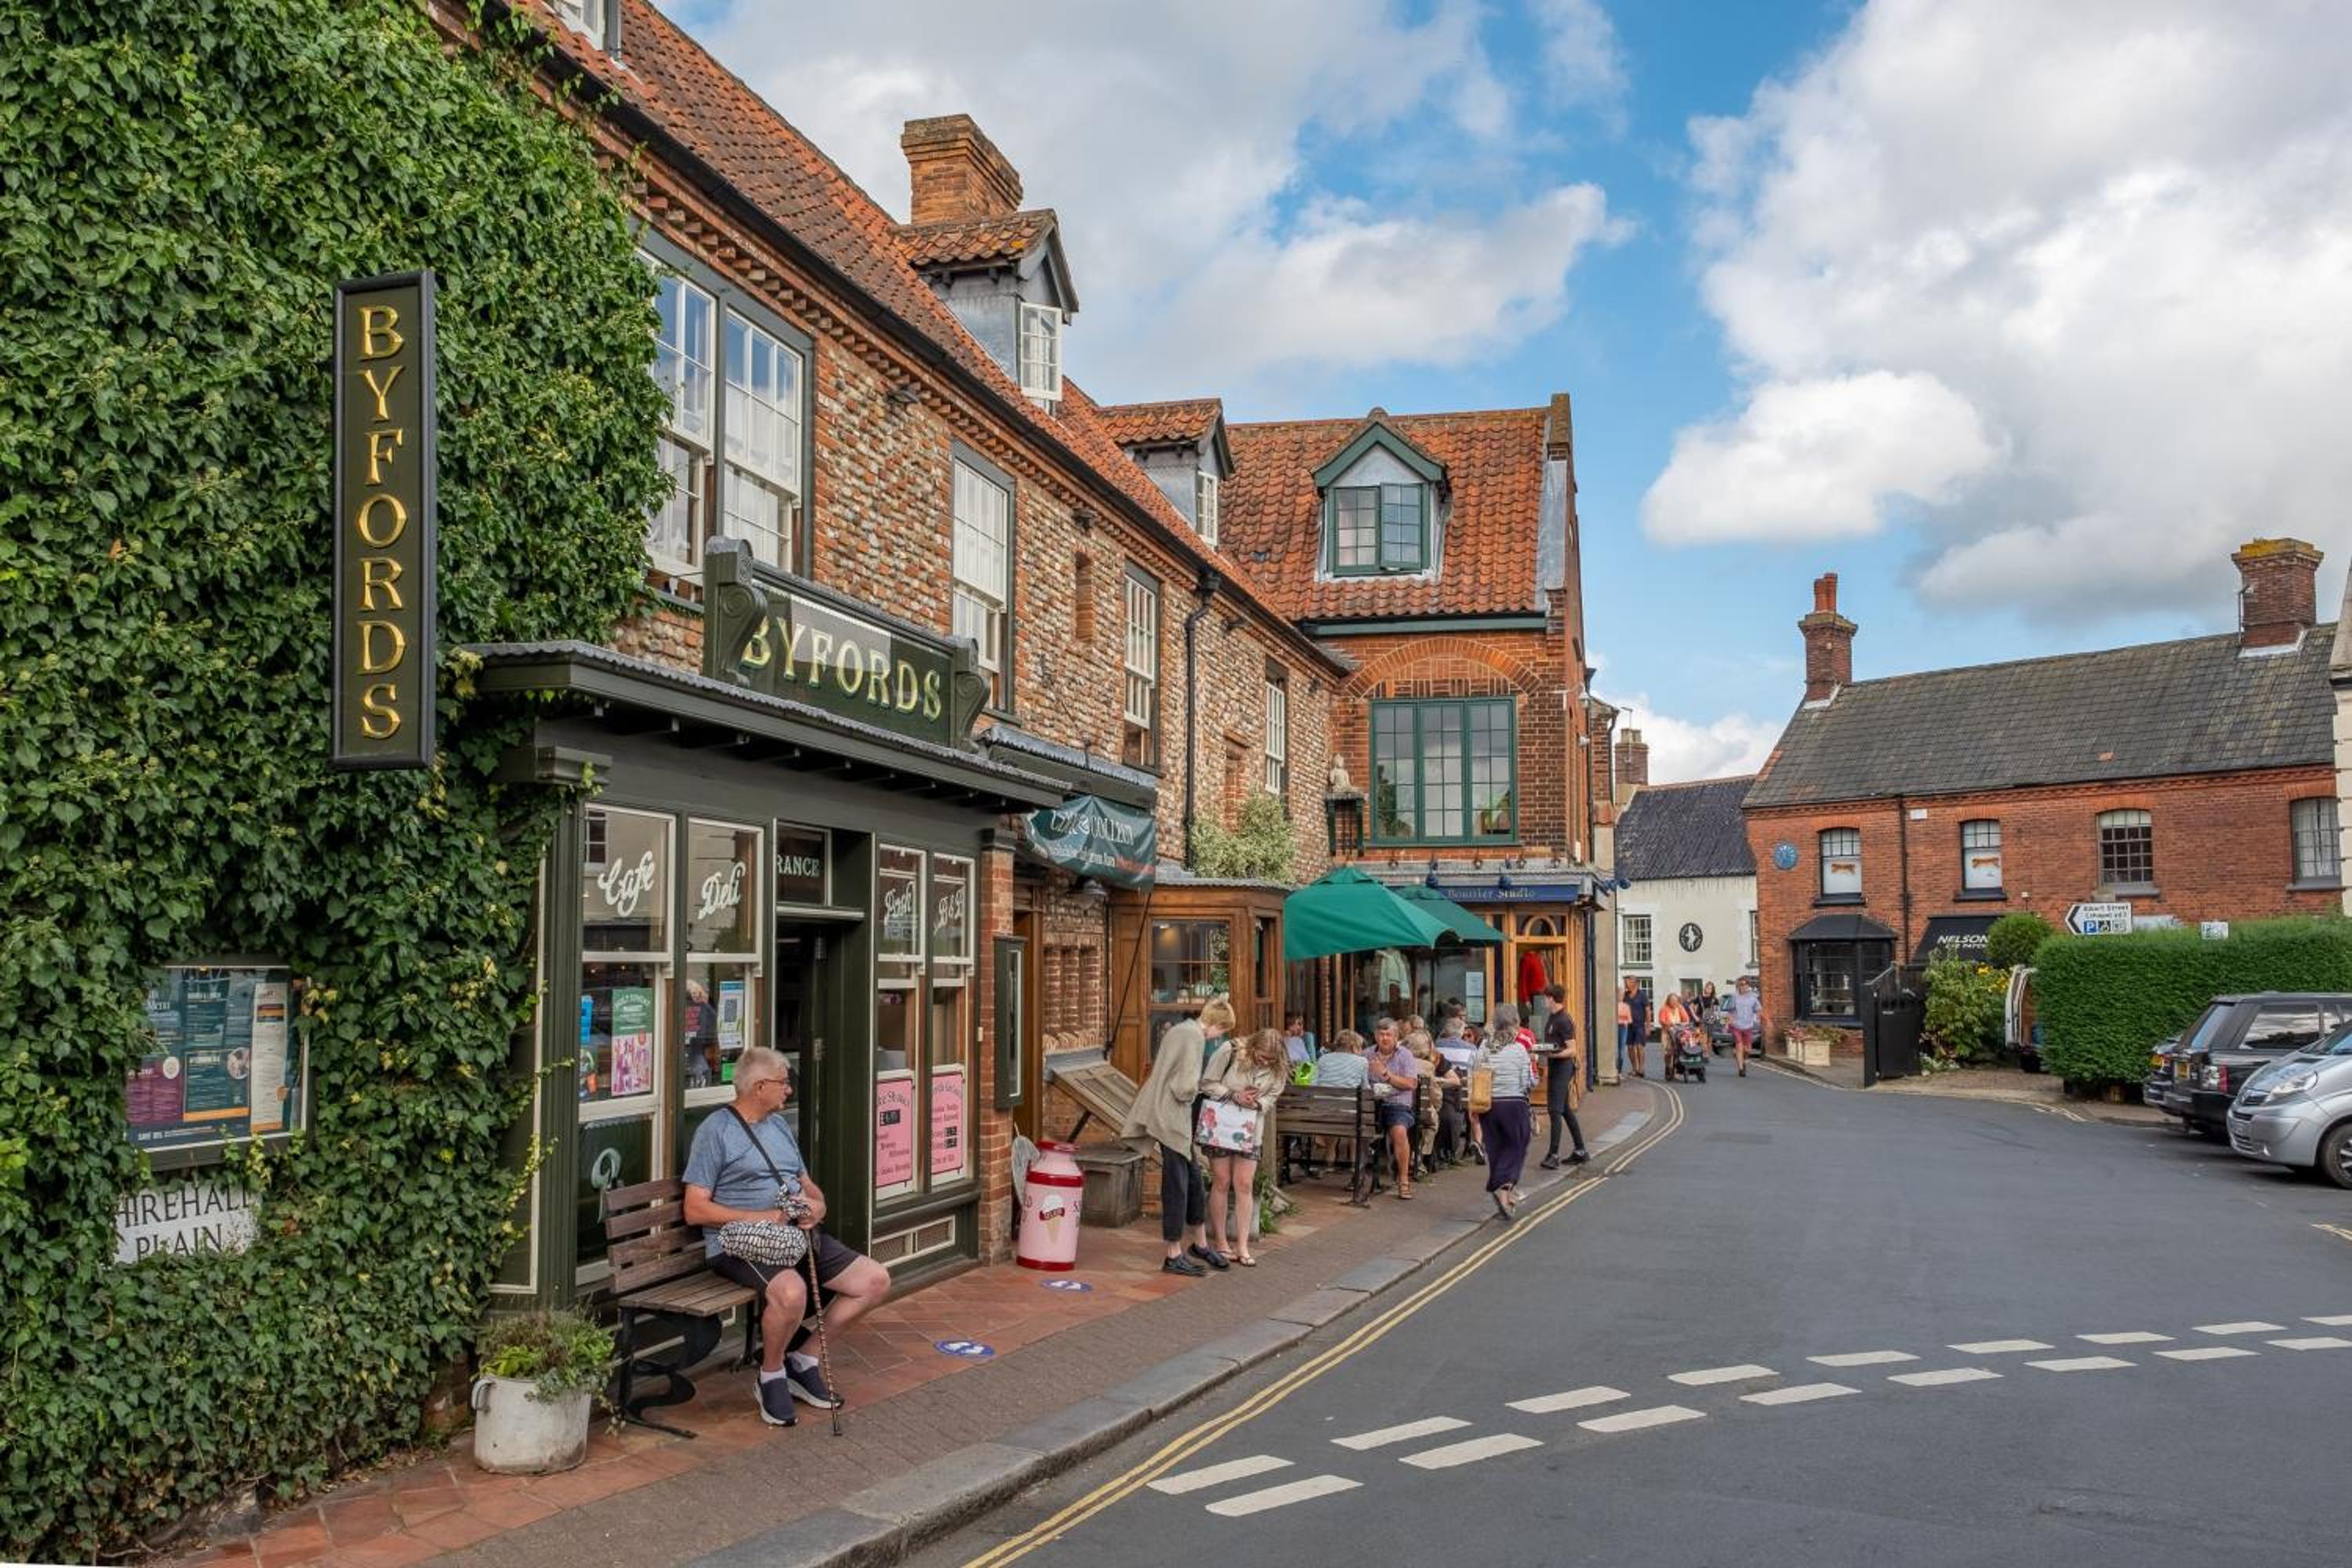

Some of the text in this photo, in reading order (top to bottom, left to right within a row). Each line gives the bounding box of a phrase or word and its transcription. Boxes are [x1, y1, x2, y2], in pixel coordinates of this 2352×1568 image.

[358, 305, 408, 739] BYFORDS
[741, 615, 942, 721] BYFORDS
[697, 862, 746, 920] Deli
[776, 854, 820, 877] RANCE
[2107, 904, 2129, 913] Street
[118, 1183, 250, 1228] HIREHALL
